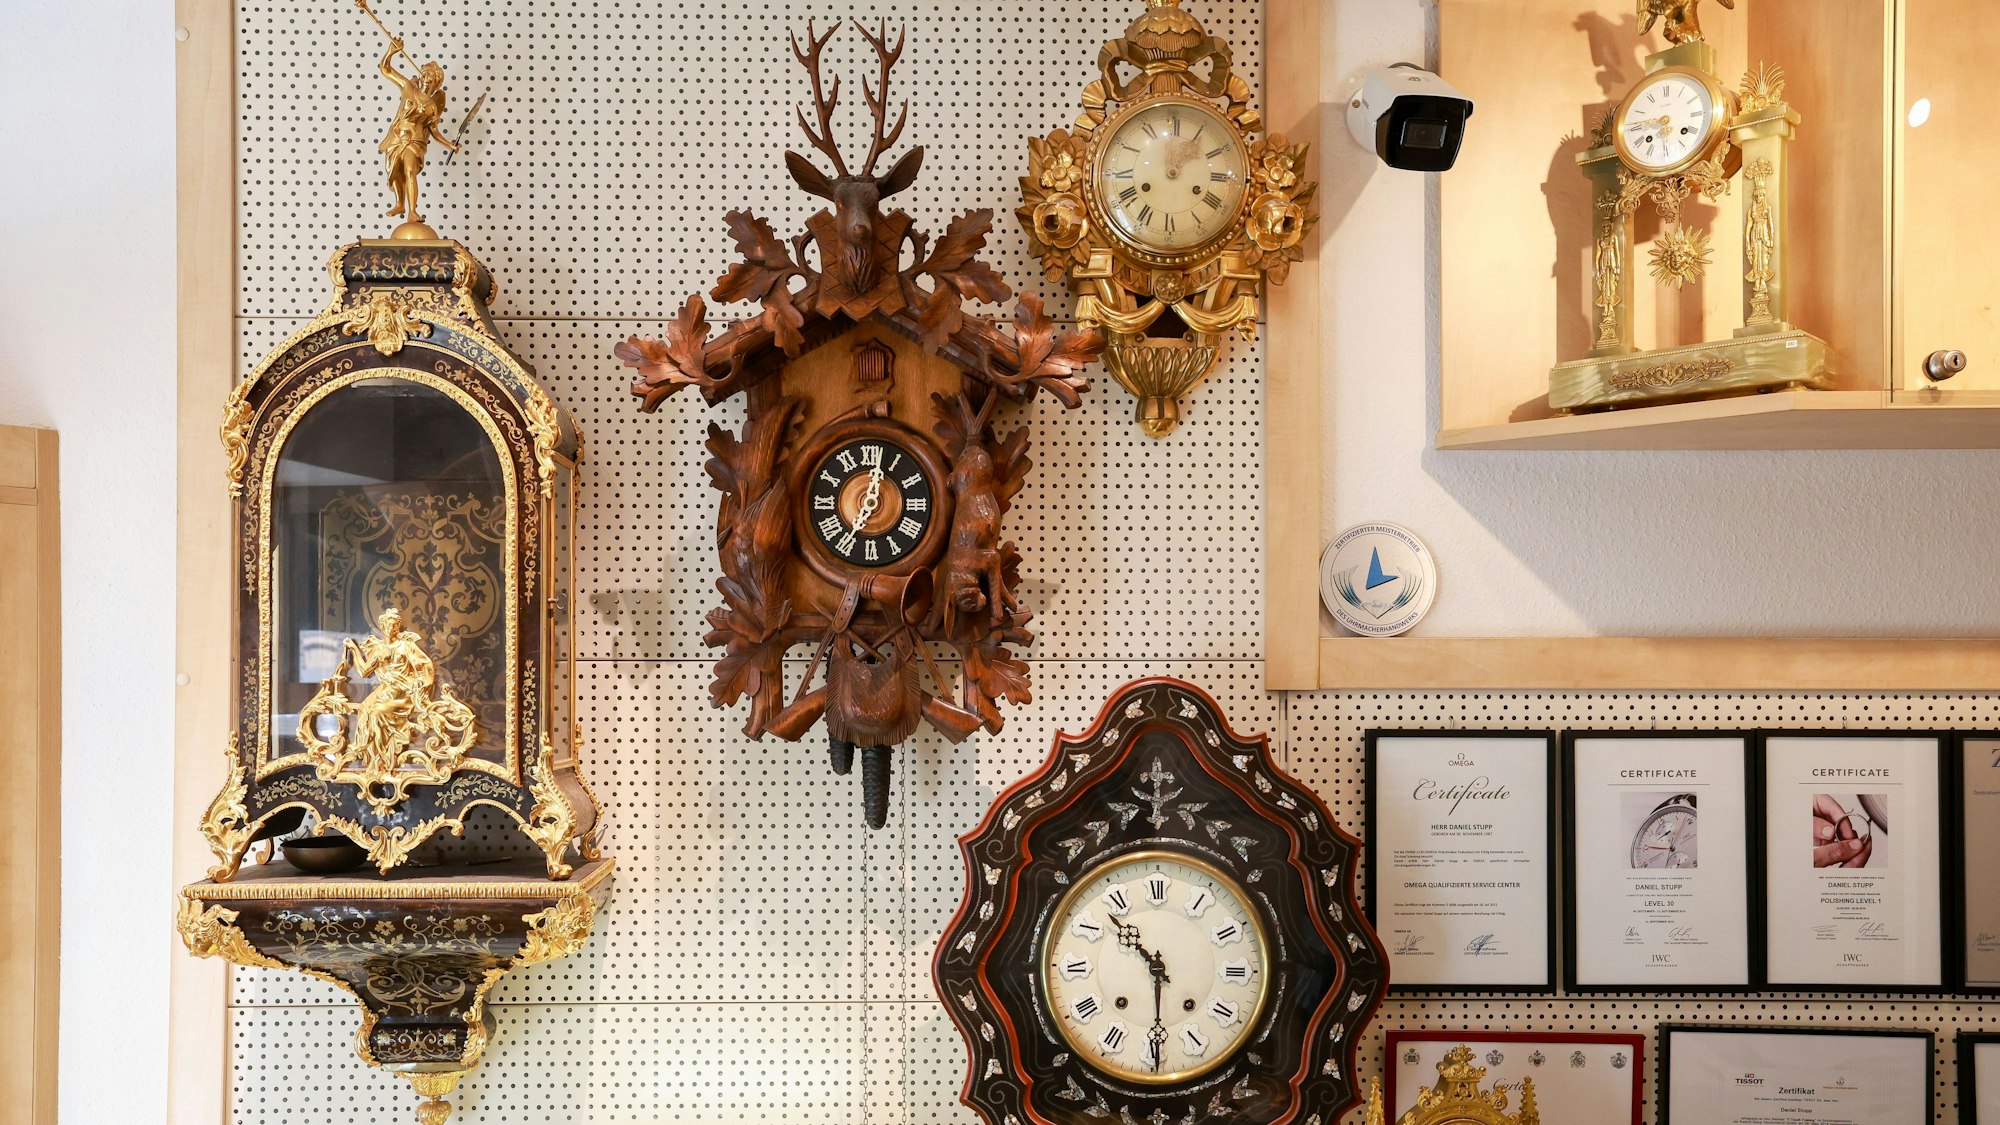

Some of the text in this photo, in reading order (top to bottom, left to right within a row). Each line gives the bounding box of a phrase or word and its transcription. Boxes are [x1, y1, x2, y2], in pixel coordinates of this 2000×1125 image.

[1335, 526, 1421, 553] ZERTIFIZIERTER MEISTERBETRIEB
[1336, 608, 1419, 633] DES UHRMACHERHANDWERKS
[1620, 769, 1698, 778] CERTIFICATE
[1812, 768, 1890, 778] CERTIFICATE
[1412, 775, 1512, 817] Certificate
[1149, 880, 1163, 900] XII
[1216, 925, 1236, 940] II
[1652, 954, 1671, 963] IWC
[1843, 953, 1863, 962] IWC
[1225, 966, 1245, 977] III
[1778, 1087, 1815, 1095] Zertifikat
